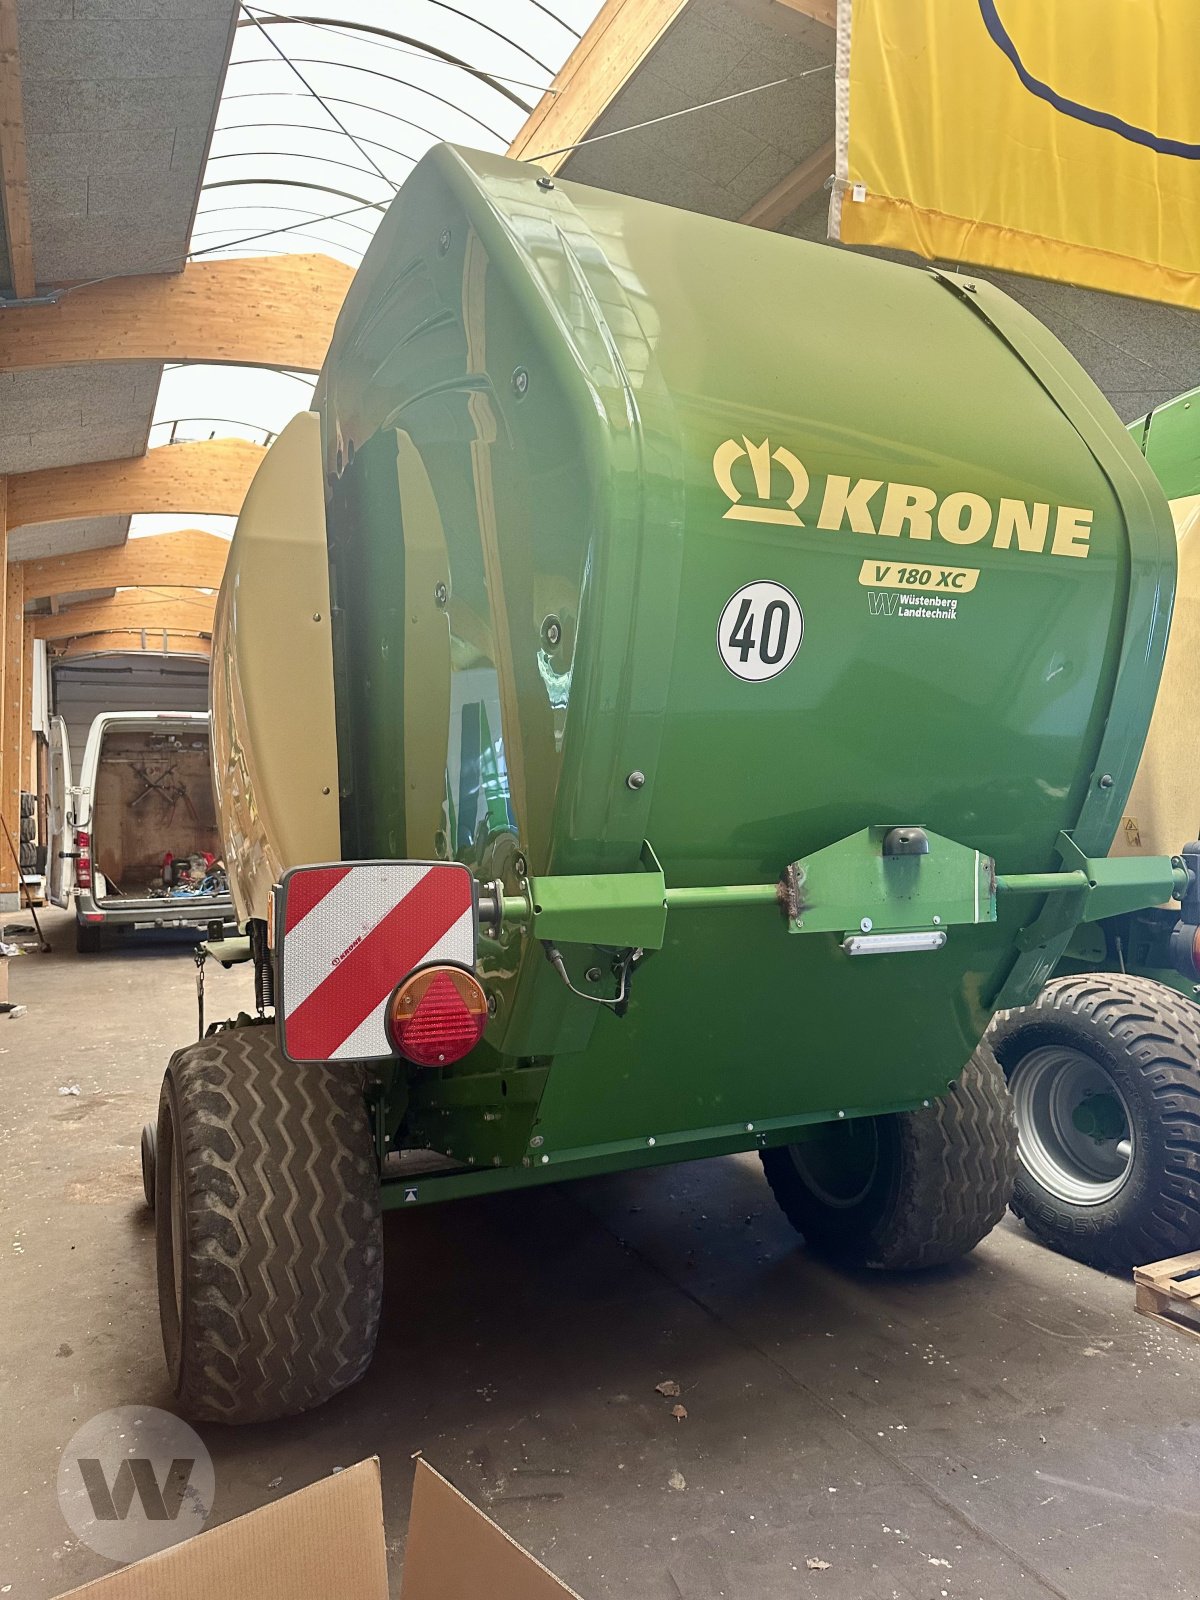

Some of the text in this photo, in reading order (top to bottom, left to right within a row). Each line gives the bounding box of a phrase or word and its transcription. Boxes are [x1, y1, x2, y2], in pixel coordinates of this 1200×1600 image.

[816, 474, 1094, 558] KRONE
[875, 566, 967, 588] V 180 XC
[900, 594, 958, 609] Wüstenberg
[898, 607, 957, 620] Landtechnik
[728, 599, 790, 664] 40
[340, 936, 362, 960] KRONE
